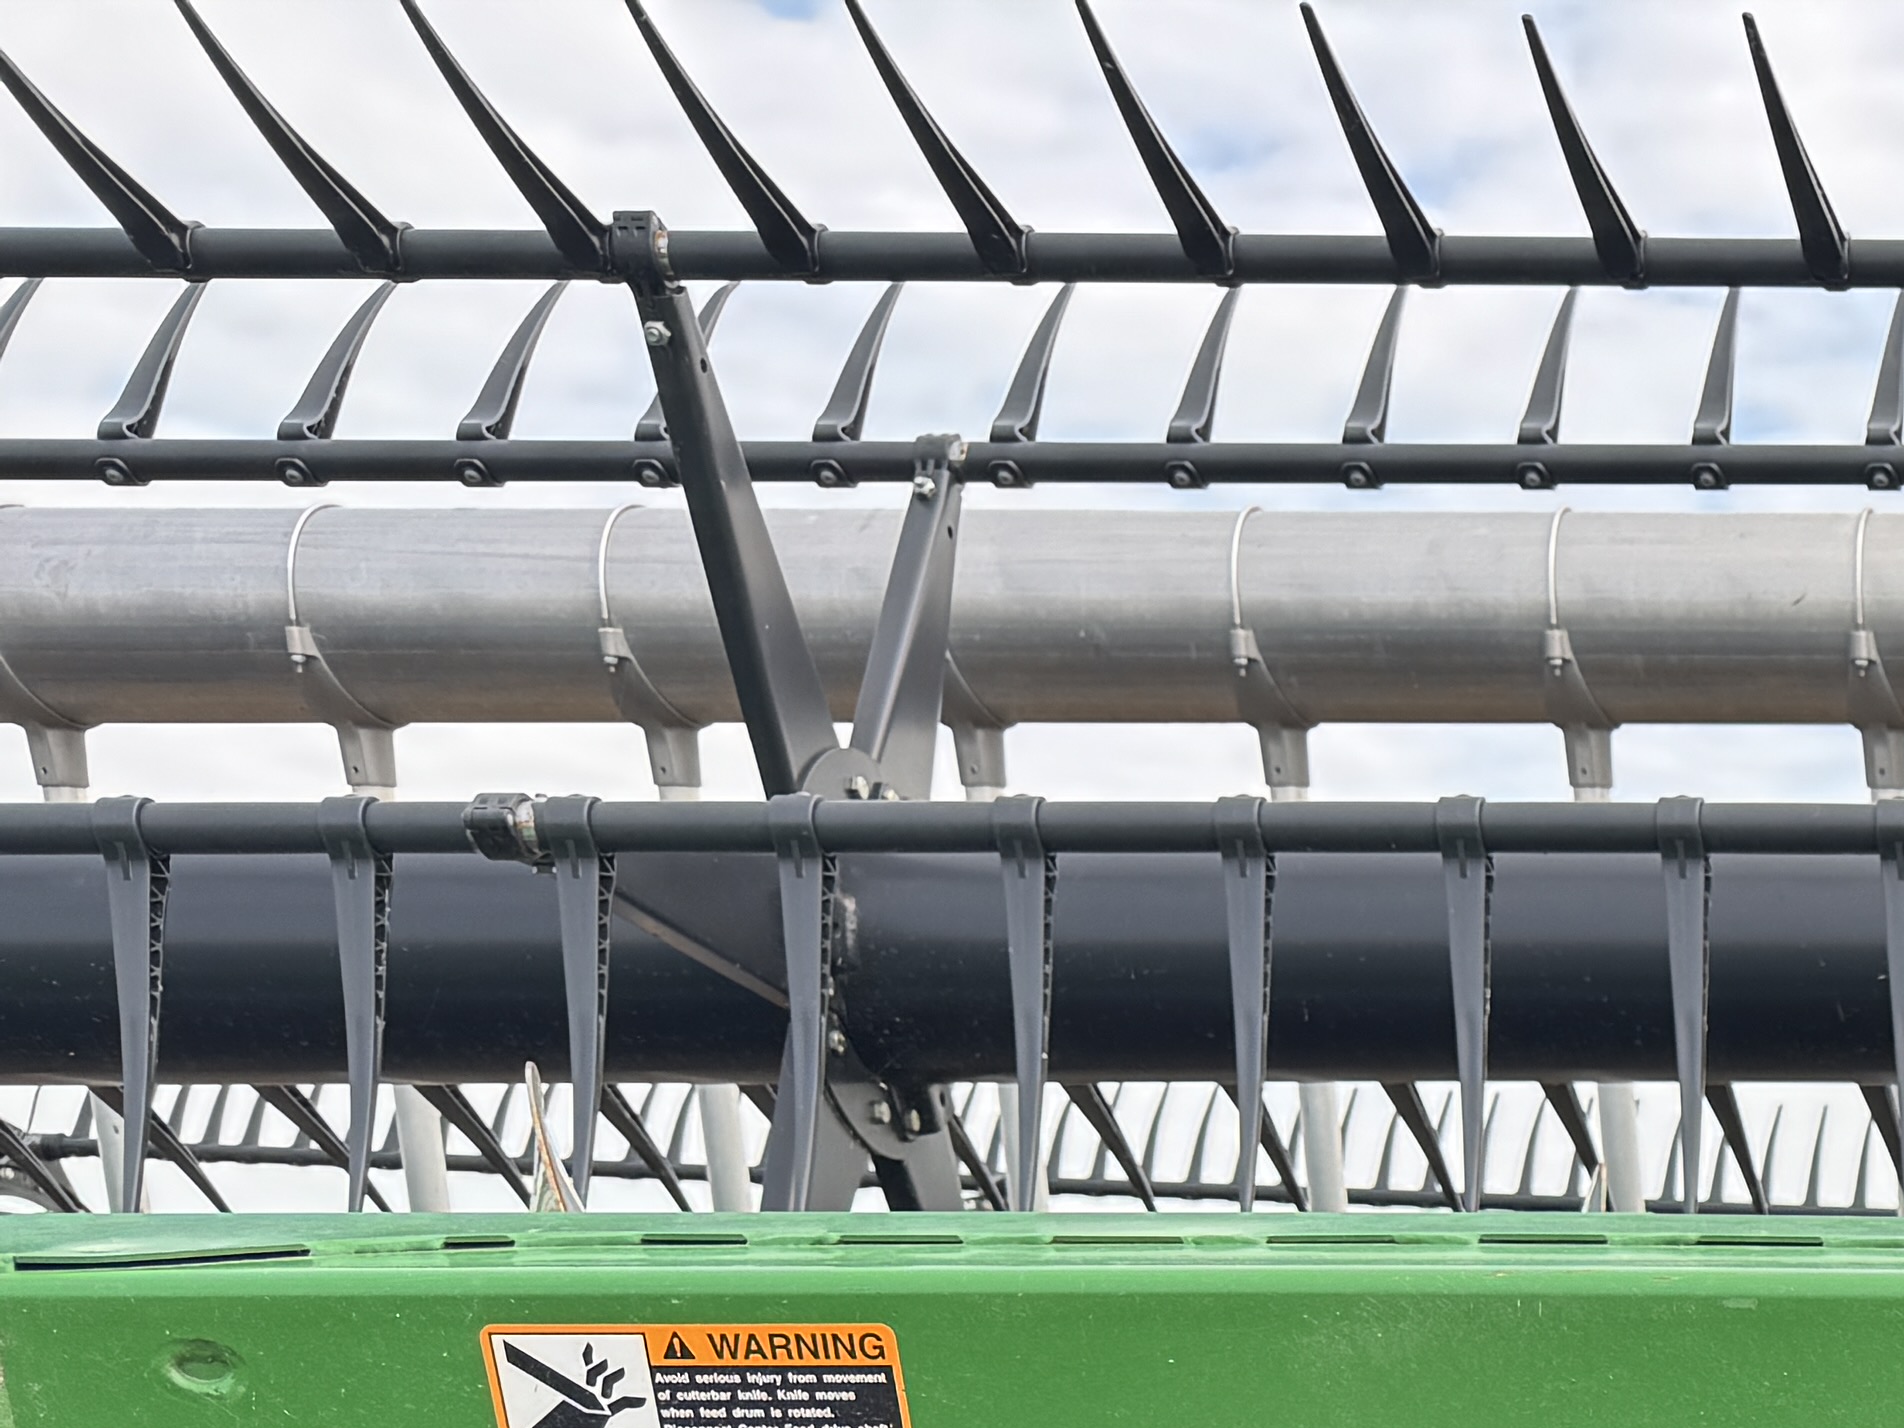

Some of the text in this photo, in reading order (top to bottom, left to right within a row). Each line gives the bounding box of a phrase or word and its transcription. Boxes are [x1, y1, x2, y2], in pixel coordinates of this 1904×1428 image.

[707, 1332, 886, 1360] WARNING
[655, 1372, 887, 1386] Avoid serious injury from movement
[658, 1389, 856, 1401] of cutterbar knife. Knife moves
[661, 1406, 835, 1418] when feed drum is rotated.
